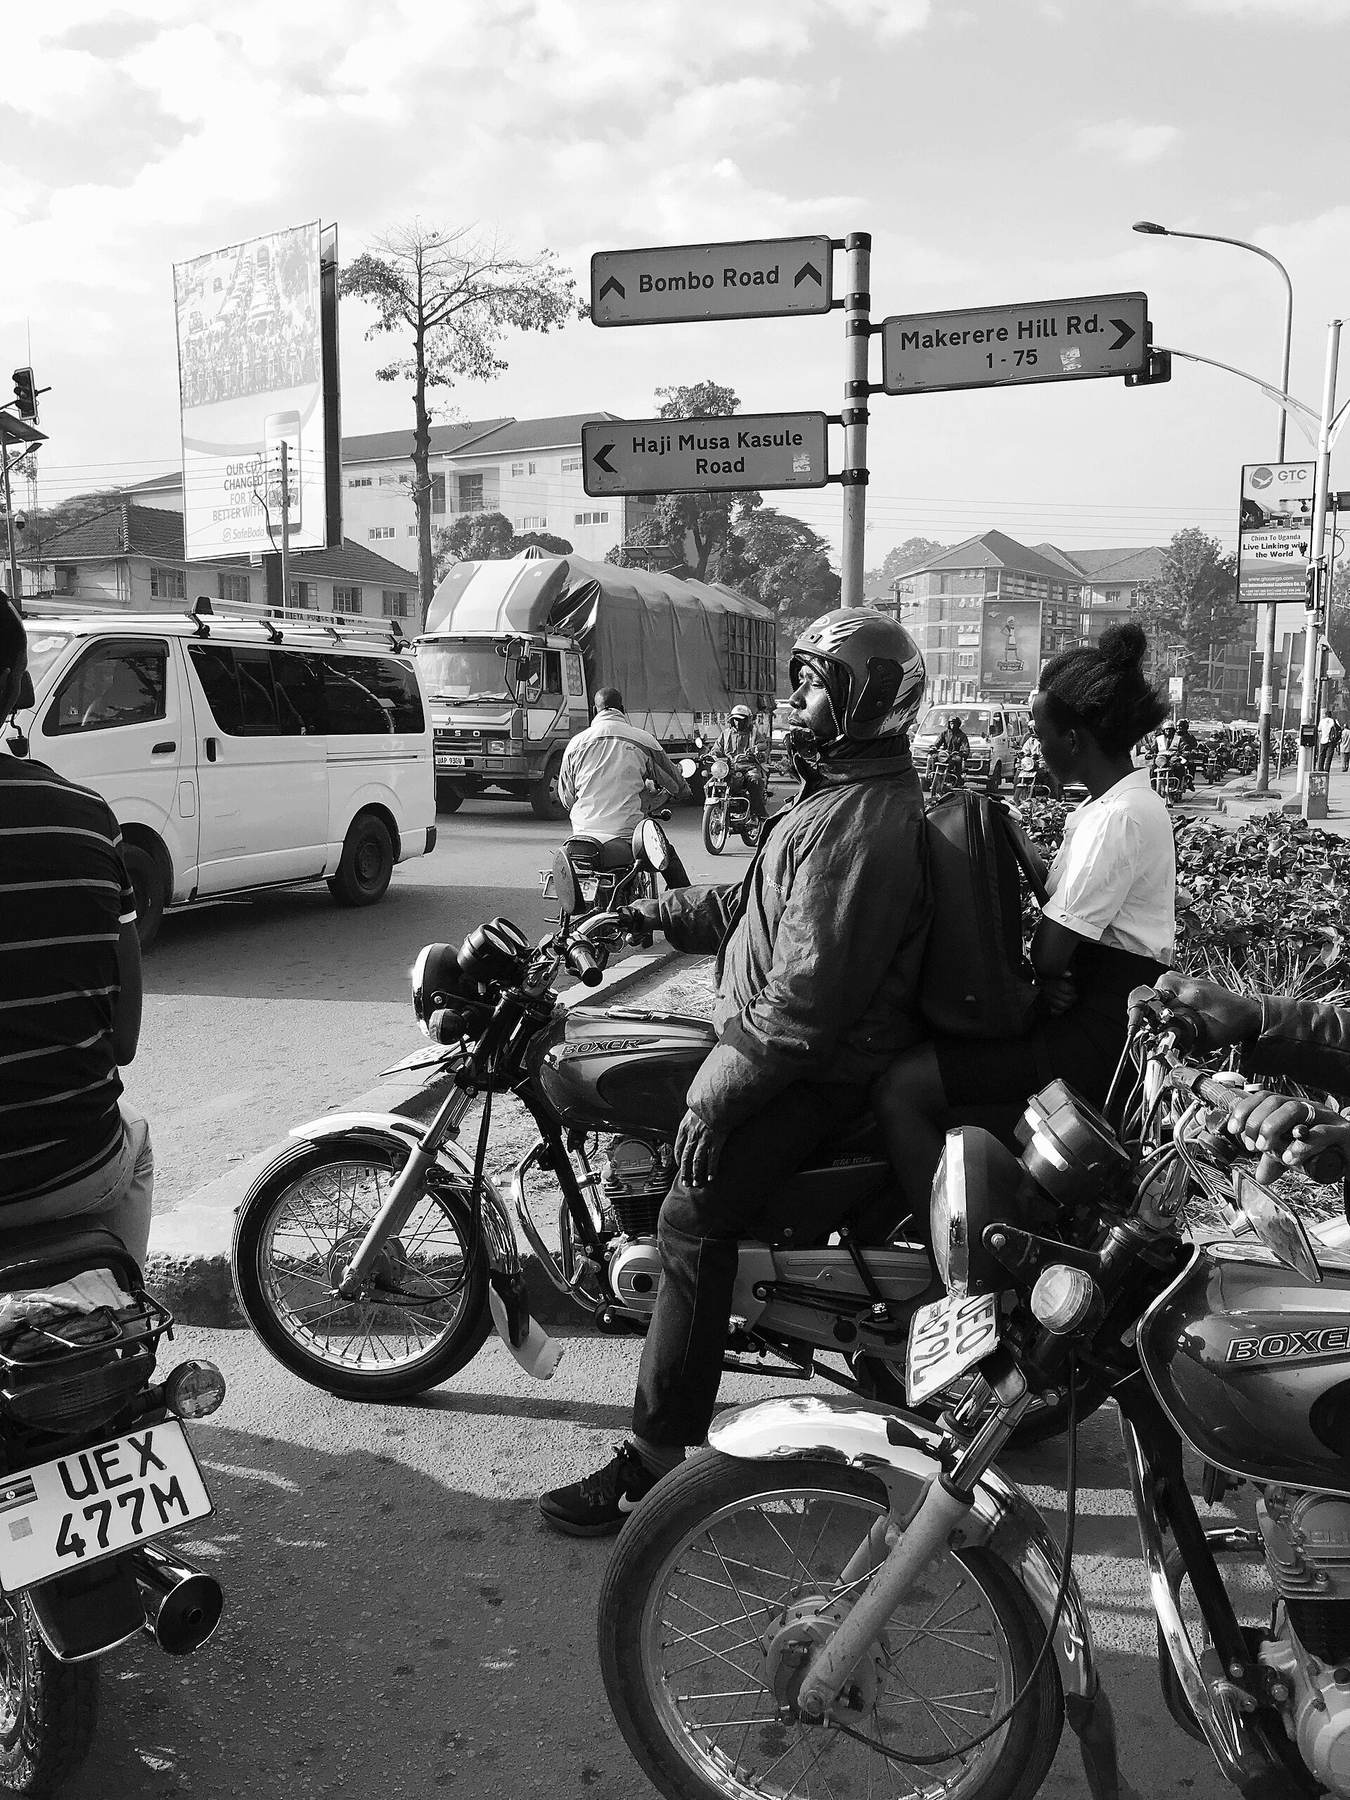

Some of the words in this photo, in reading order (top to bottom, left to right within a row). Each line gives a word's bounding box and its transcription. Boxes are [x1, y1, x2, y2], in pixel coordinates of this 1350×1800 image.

[639, 270, 714, 294] Bombo
[723, 265, 780, 288] Road
[900, 326, 1008, 351] Makerere
[1016, 318, 1057, 340] Hill
[1066, 313, 1105, 336] Rd.
[632, 434, 671, 456] Haji
[677, 434, 730, 451] Musa
[736, 428, 803, 449] Kasule
[226, 463, 244, 476] OUR
[695, 455, 745, 475] Road
[224, 474, 264, 491] CHANGED
[1278, 469, 1307, 481] GTC
[230, 492, 246, 505] FOR
[213, 507, 241, 521] BETTER
[242, 505, 264, 518] WITH
[1261, 543, 1289, 551] Linking
[1278, 534, 1301, 542] Uganda
[561, 1038, 641, 1056] BOXER
[1225, 1326, 1350, 1362] BOXE
[57, 1431, 167, 1501] UEX
[55, 1475, 190, 1558] 477M
